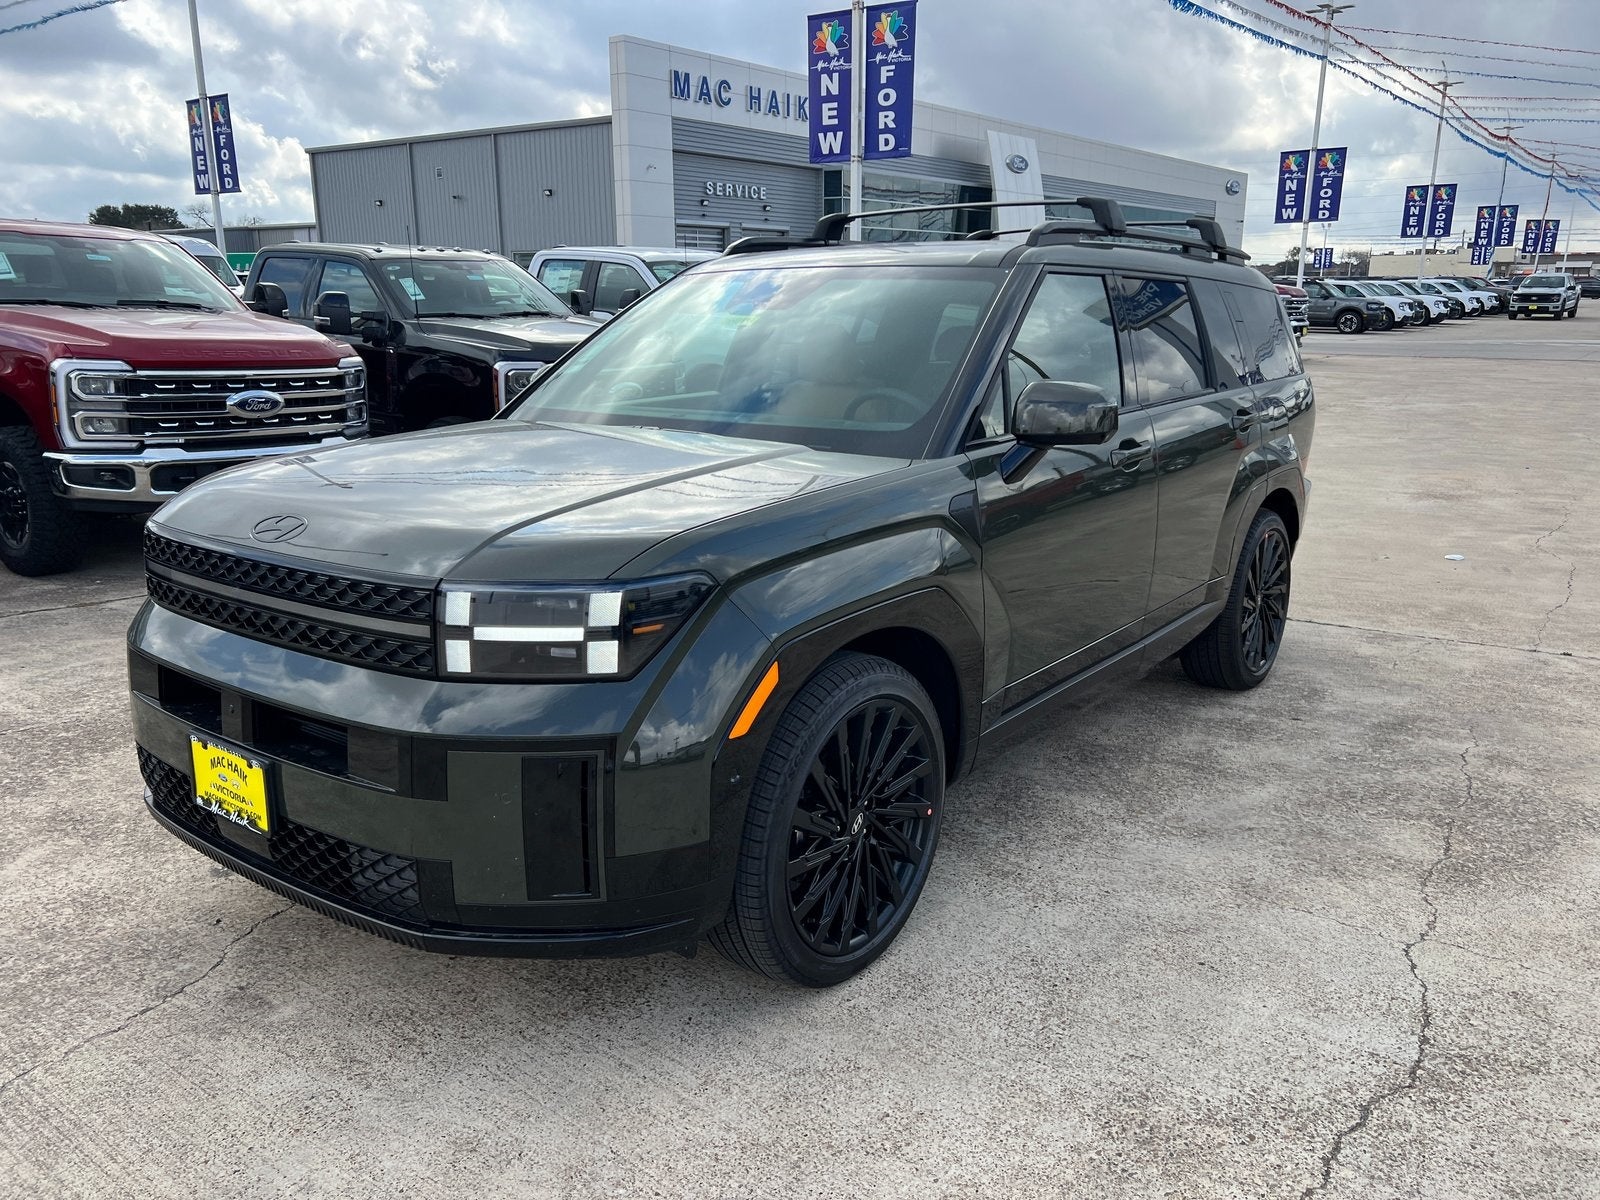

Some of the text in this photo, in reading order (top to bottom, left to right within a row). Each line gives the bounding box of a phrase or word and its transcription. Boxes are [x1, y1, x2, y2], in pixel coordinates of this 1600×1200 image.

[671, 69, 808, 122] MAC HAIK
[878, 65, 897, 151] FORD
[818, 73, 843, 155] NEW
[194, 136, 209, 189] NEW
[219, 134, 233, 189] FORD
[706, 181, 767, 199] SERVICE
[1281, 179, 1298, 220] NEW
[1318, 177, 1333, 219] FORD
[1406, 206, 1419, 236] NEW
[1434, 205, 1446, 236] FORD
[1478, 222, 1489, 245] NEW
[1500, 221, 1510, 245] FORD
[1525, 232, 1535, 252] NEW
[1544, 232, 1553, 252] FORD
[245, 398, 272, 411] Ford
[210, 756, 226, 770] MAC
[227, 761, 248, 787] HAIK
[216, 785, 247, 806] VICTORIA
